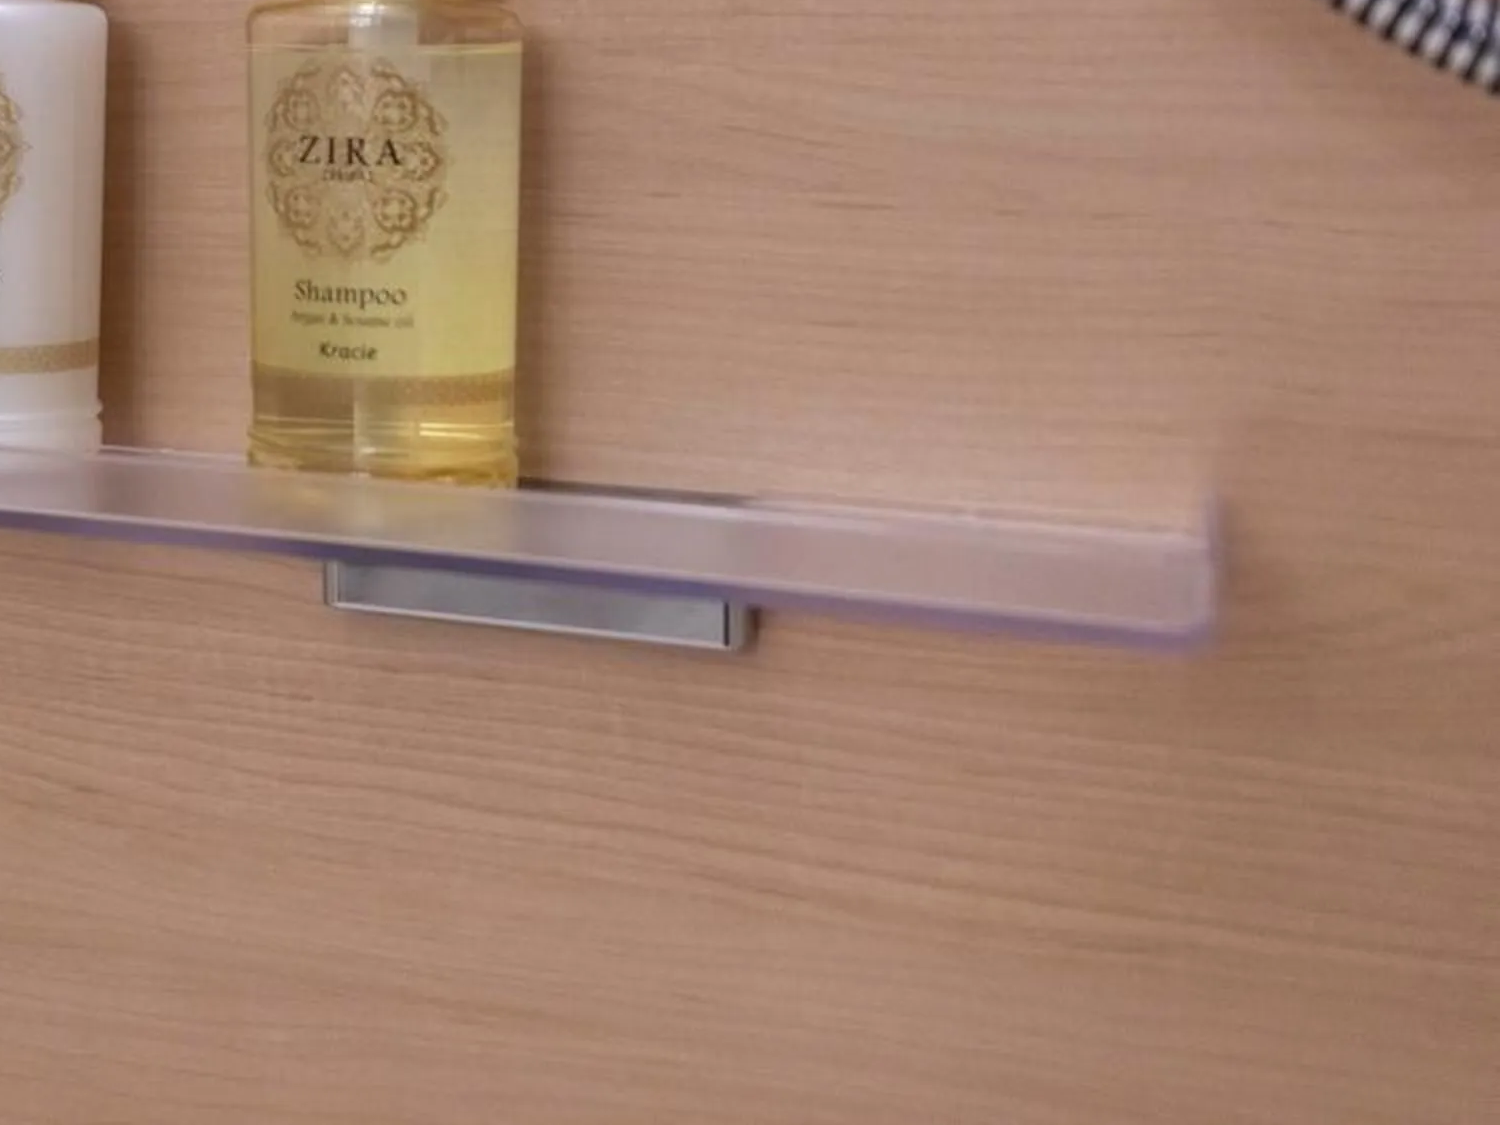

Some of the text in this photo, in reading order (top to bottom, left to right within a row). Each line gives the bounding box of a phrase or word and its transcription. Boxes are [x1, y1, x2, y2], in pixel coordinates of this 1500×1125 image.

[299, 135, 402, 167] ZIRA
[294, 279, 408, 310] Shampoo
[320, 341, 378, 360] Kracie
